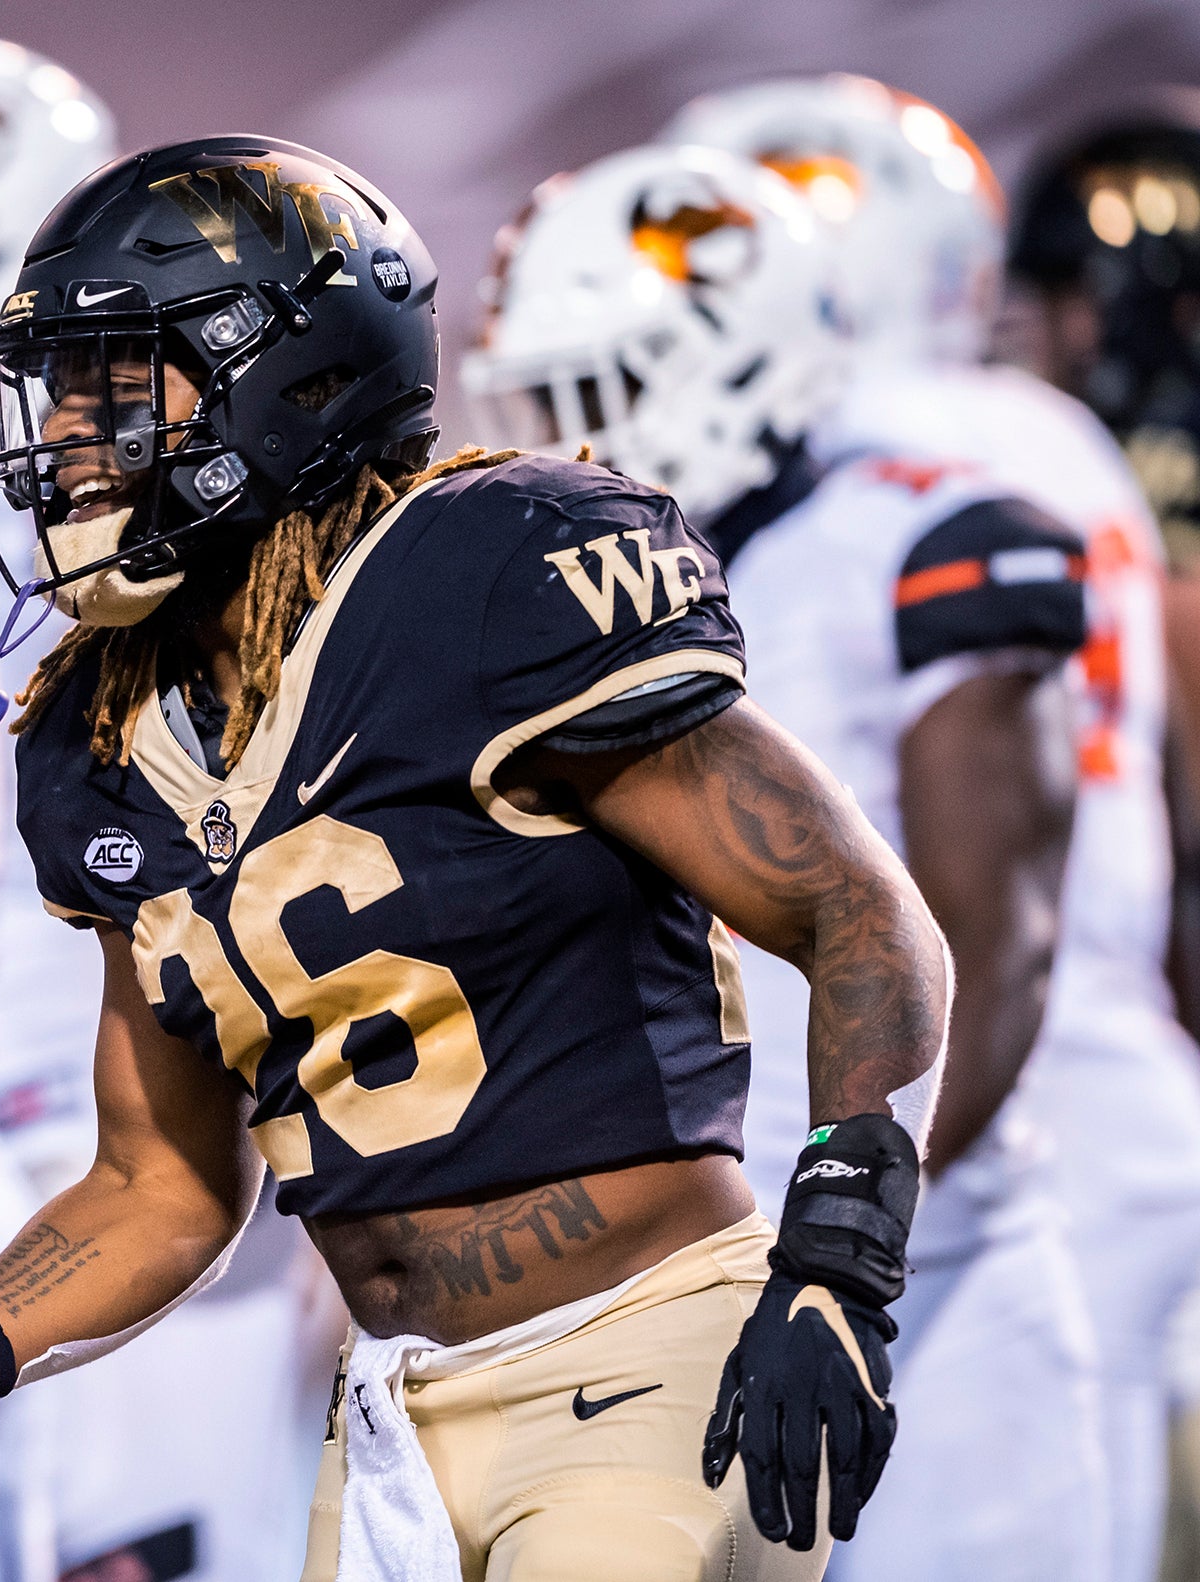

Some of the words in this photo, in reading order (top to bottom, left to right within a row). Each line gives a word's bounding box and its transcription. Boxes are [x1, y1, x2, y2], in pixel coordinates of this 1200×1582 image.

[148, 161, 367, 287] WF
[373, 261, 407, 277] BREONNA
[380, 272, 409, 288] TAYLOR
[543, 528, 705, 636] WF
[91, 842, 135, 865] ACC
[131, 814, 487, 1182] 26
[424, 1178, 608, 1298] MITH
